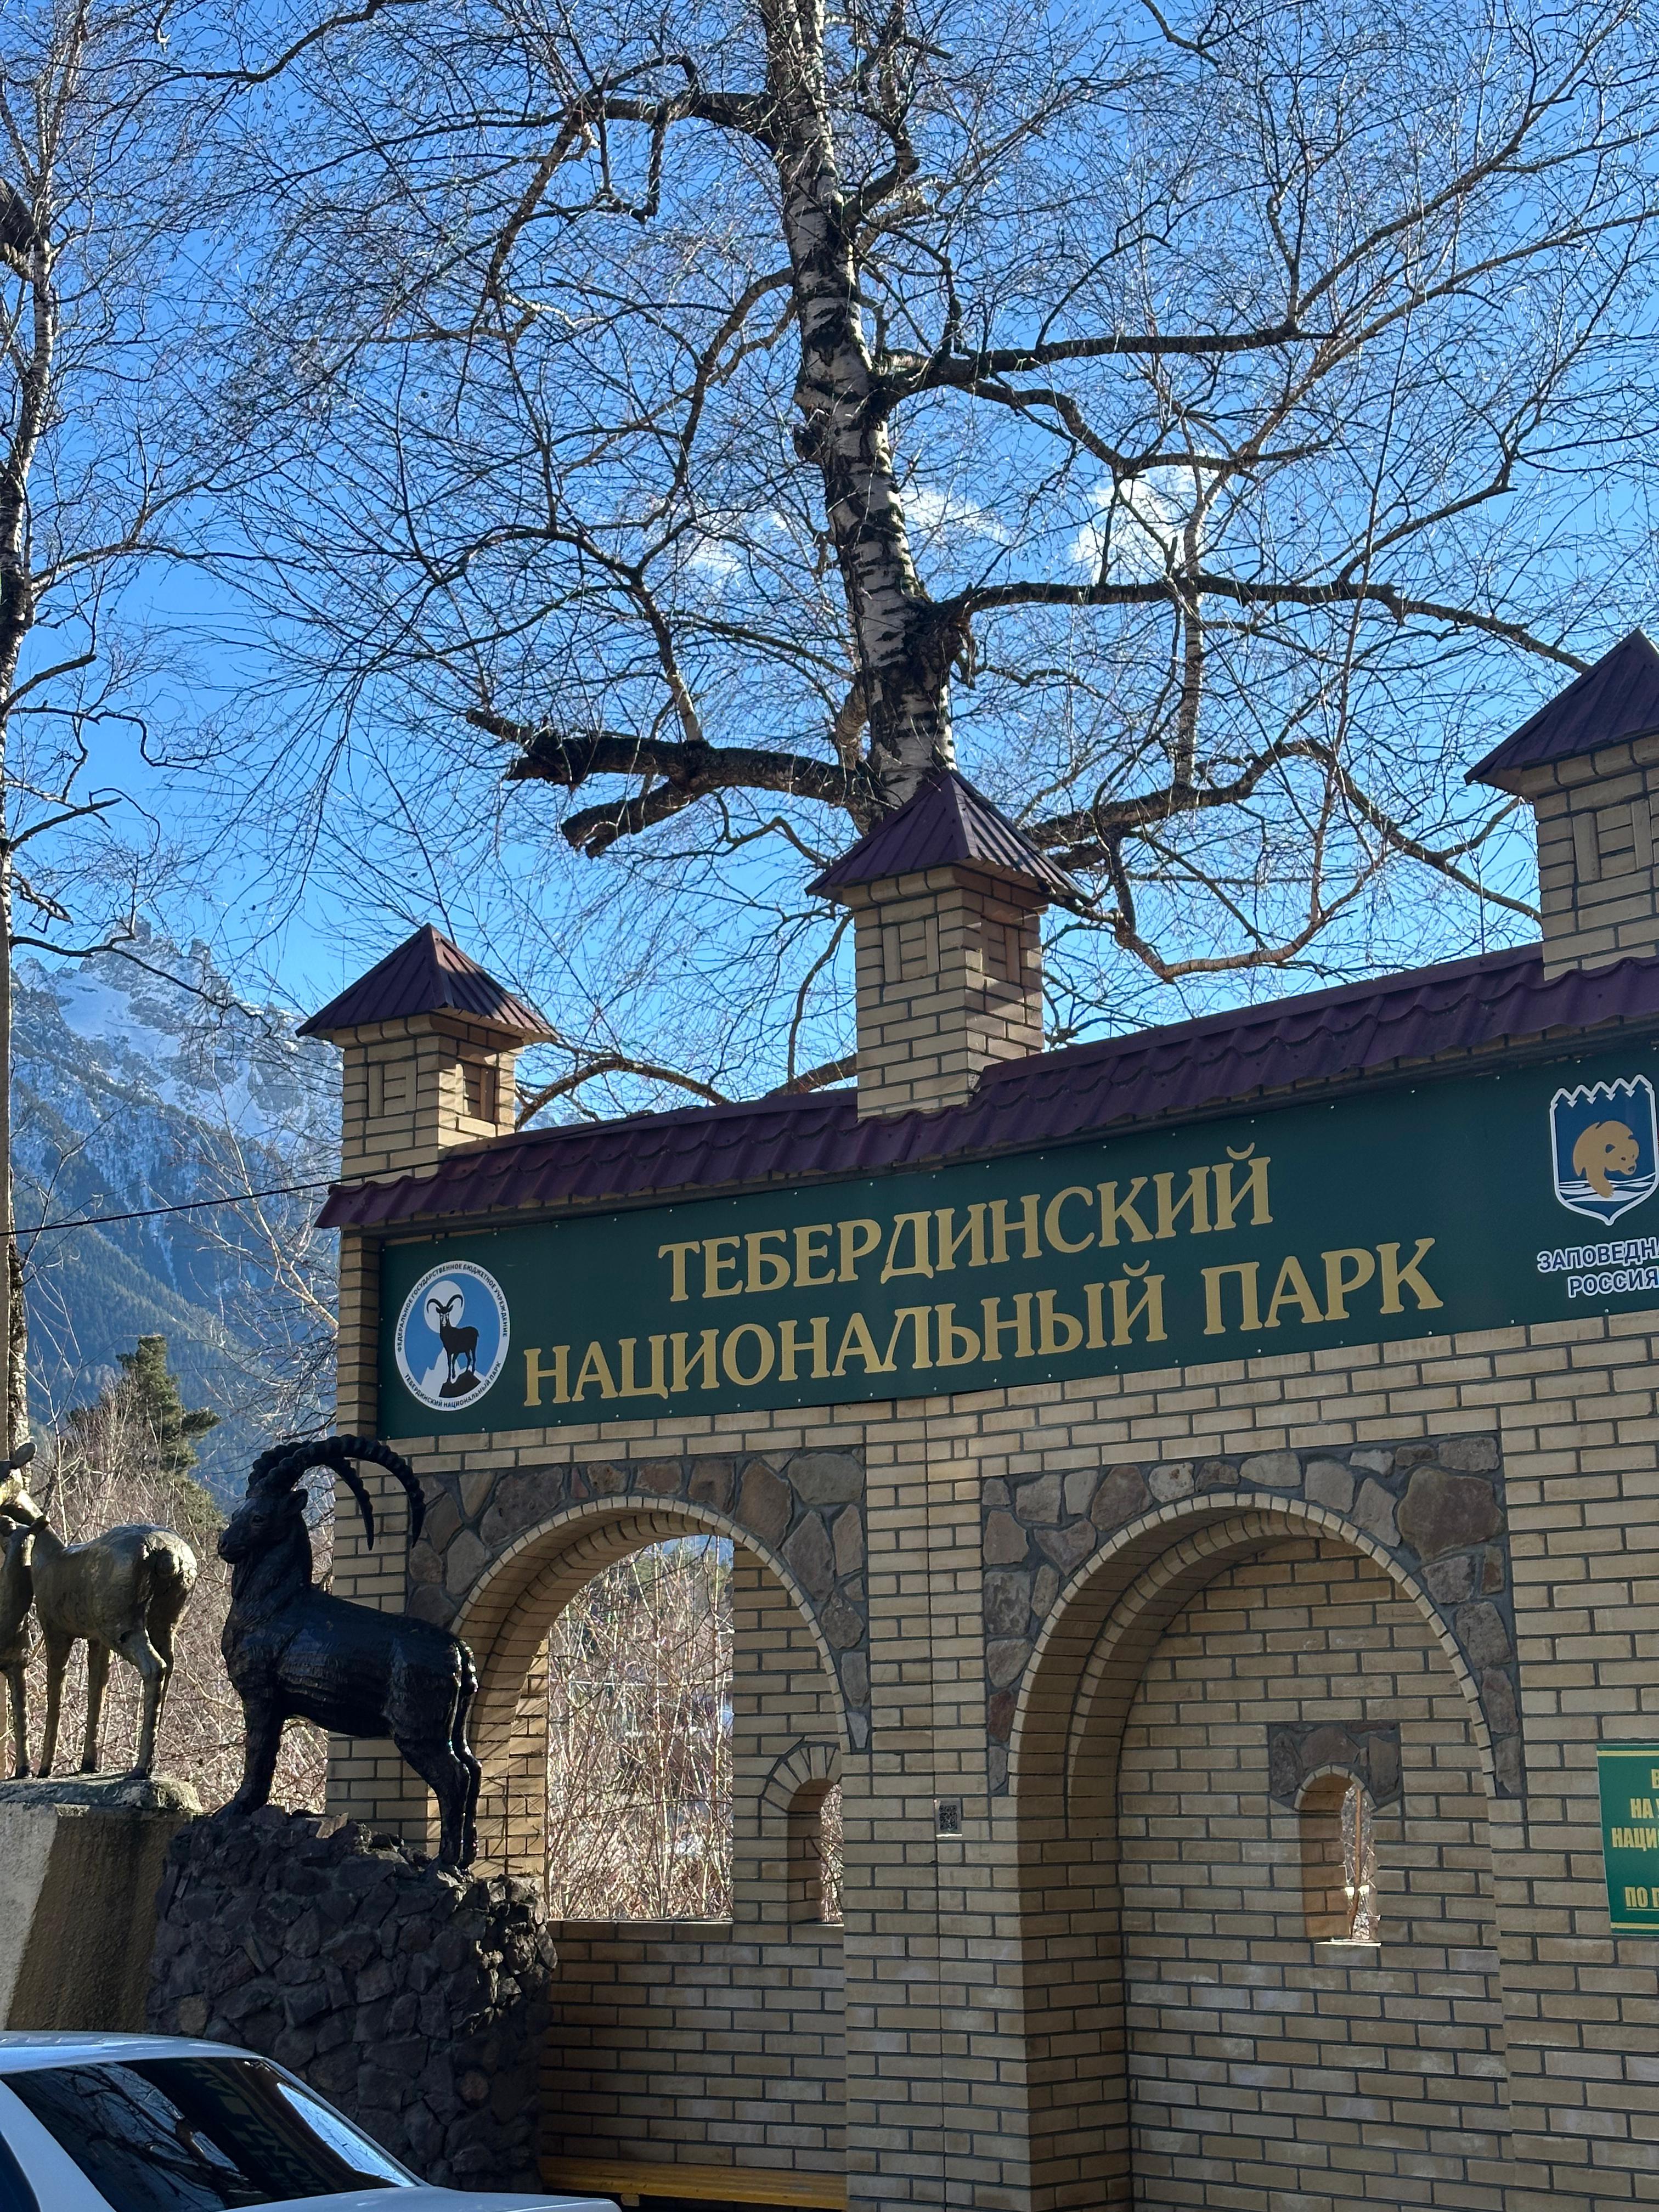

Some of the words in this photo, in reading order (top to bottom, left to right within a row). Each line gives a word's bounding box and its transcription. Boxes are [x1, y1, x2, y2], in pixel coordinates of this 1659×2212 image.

[659, 1142, 1273, 1302] ТЕБЕРДИНСКИЙ
[1537, 1237, 1659, 1273] ЗАПОВЕДН
[411, 1263, 462, 1300] ГОСУДАРСТВЕННОЕ
[462, 1264, 496, 1289] БЮДЖЕТНОЕ
[494, 1288, 507, 1337] УЧРЕЖДЕНИЕ
[1567, 1266, 1659, 1298] РОССИЯ
[524, 1260, 1167, 1406] НАЦИОНАЛЬНЫЙ
[1201, 1238, 1443, 1335] ПАРК
[405, 1373, 443, 1408] ТЕБЕРДИНСКИЙ
[443, 1379, 490, 1408] НАЦИОНАЛЬНЫЙ
[489, 1361, 501, 1381] ПАРК
[1630, 1798, 1654, 1818] НА
[1611, 1827, 1659, 1852] НАЦИ
[1625, 1887, 1649, 1908] ПО
